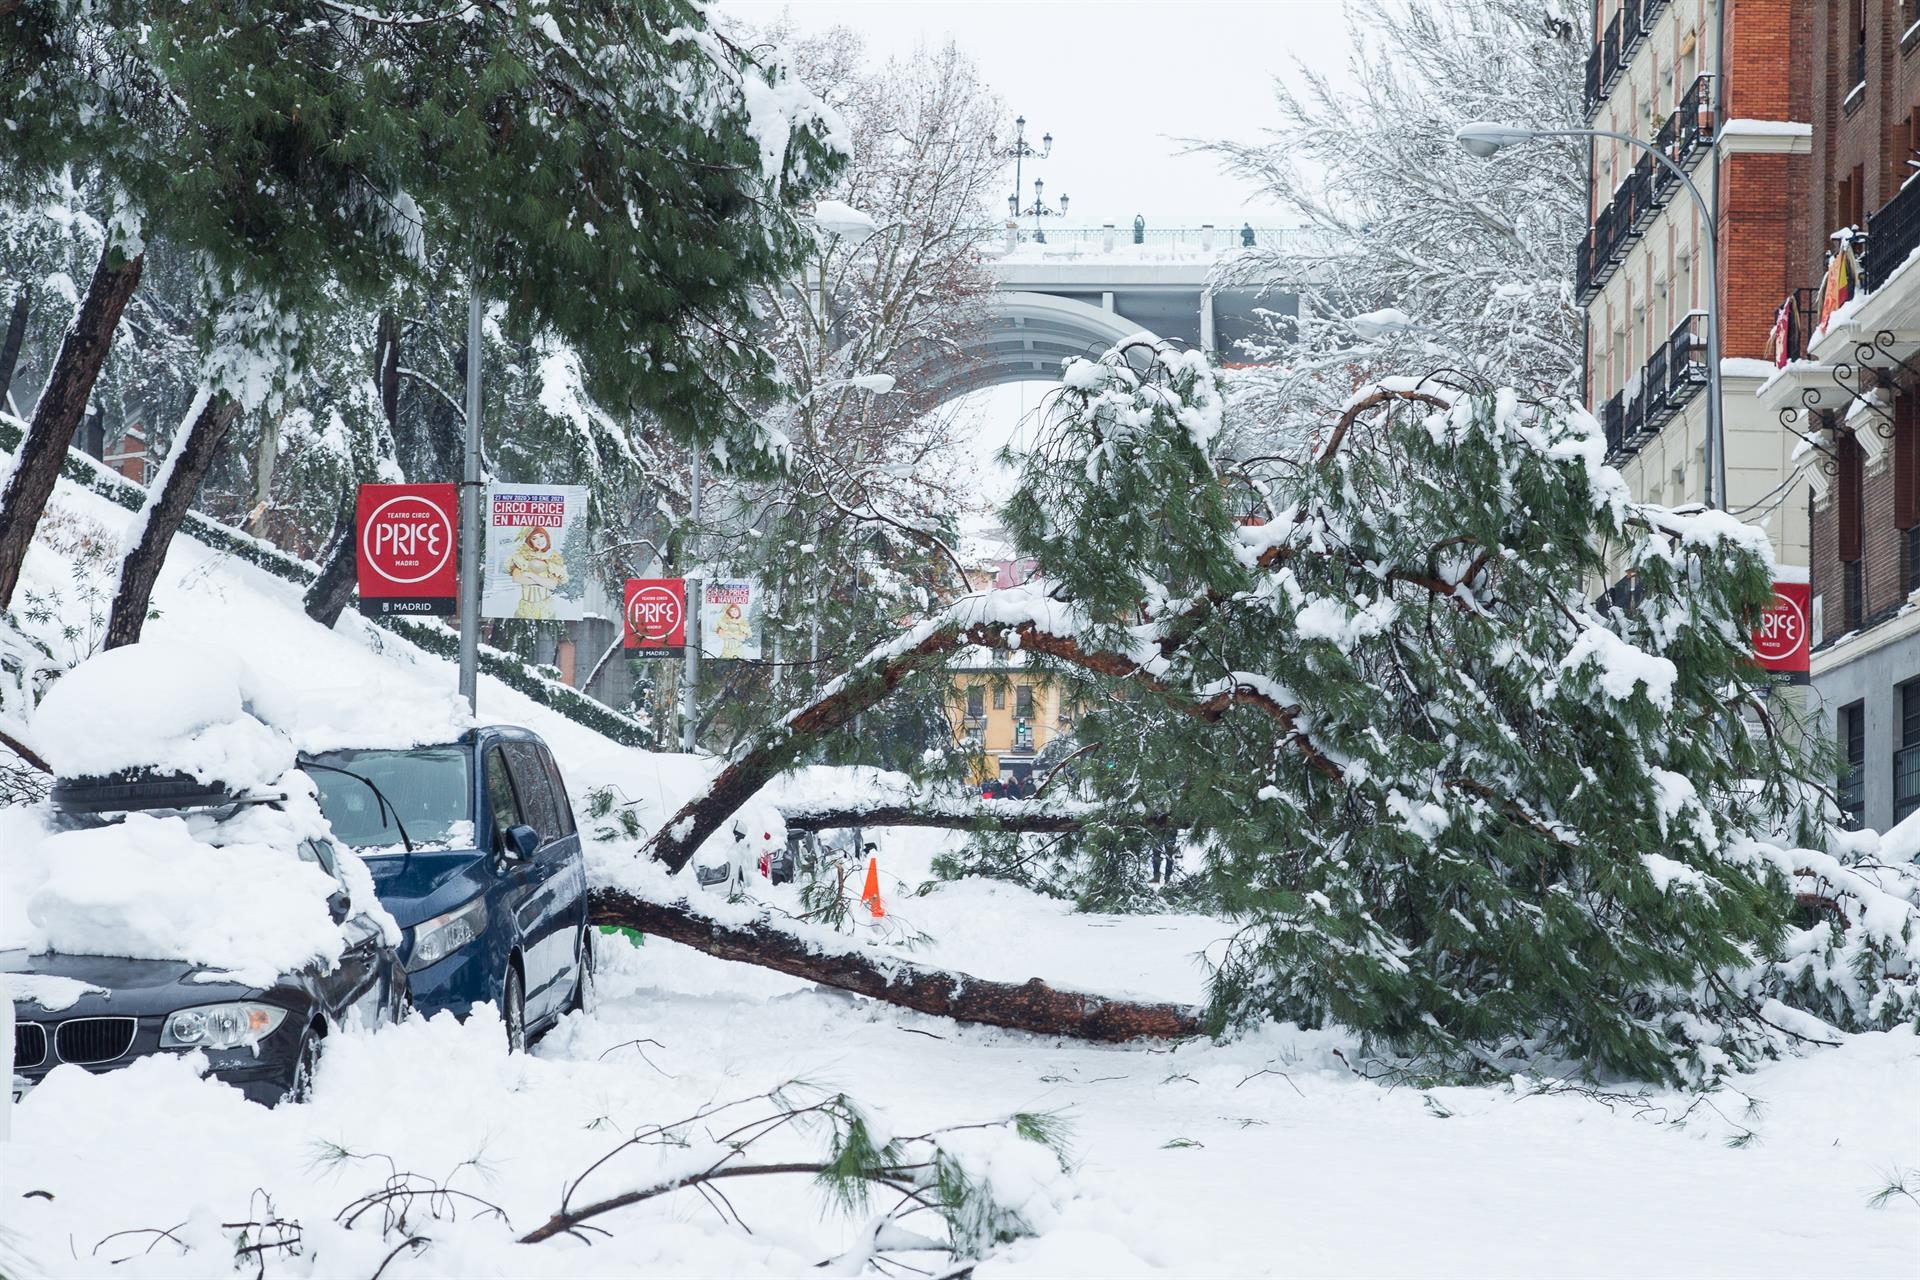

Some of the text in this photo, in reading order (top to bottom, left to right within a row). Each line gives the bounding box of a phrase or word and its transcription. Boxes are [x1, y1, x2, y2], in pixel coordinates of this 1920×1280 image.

[494, 502, 563, 514] CIRCO PRICE
[494, 515, 561, 527] EN NAVIDAD
[375, 523, 441, 556] PRICE
[393, 602, 432, 611] MADRID
[635, 603, 674, 623] PRICE
